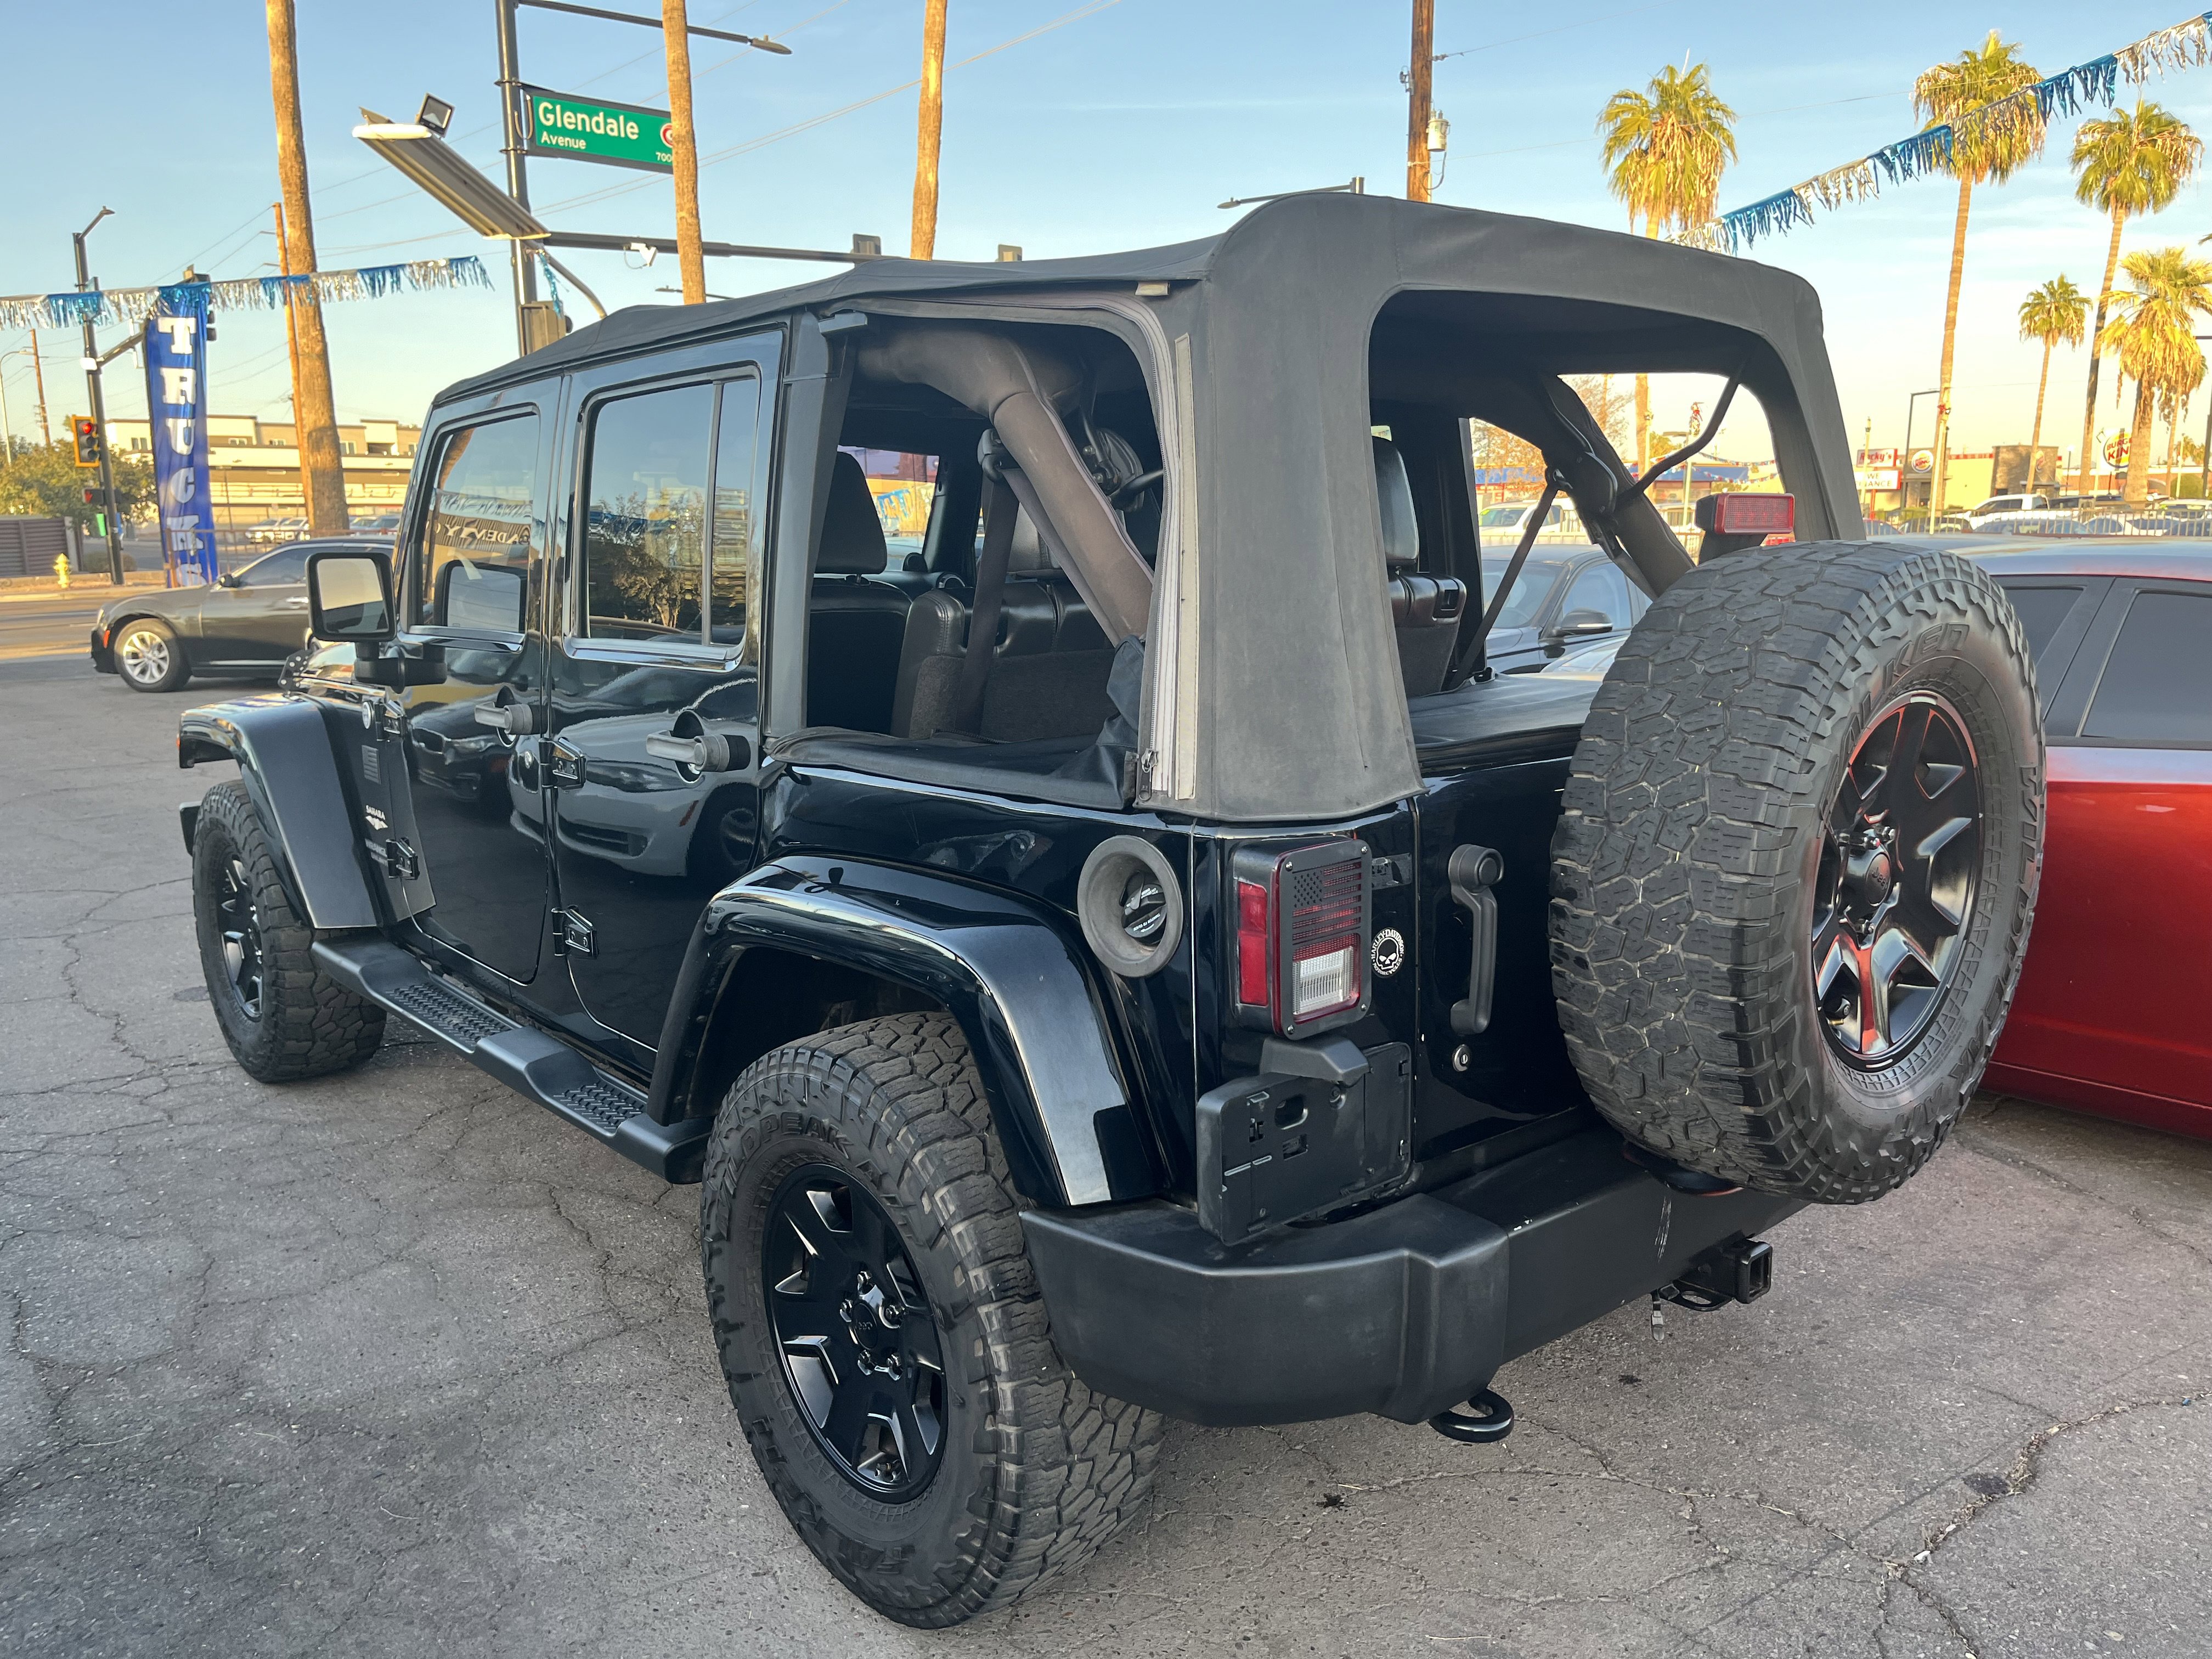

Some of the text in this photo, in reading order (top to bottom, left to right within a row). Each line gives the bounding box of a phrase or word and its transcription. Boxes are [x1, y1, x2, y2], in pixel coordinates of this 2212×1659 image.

[538, 101, 640, 140] Glendale
[540, 131, 586, 150] Avenue
[656, 151, 673, 163] 700
[1860, 452, 1892, 464] Rcky's
[2107, 446, 2130, 461] KIN
